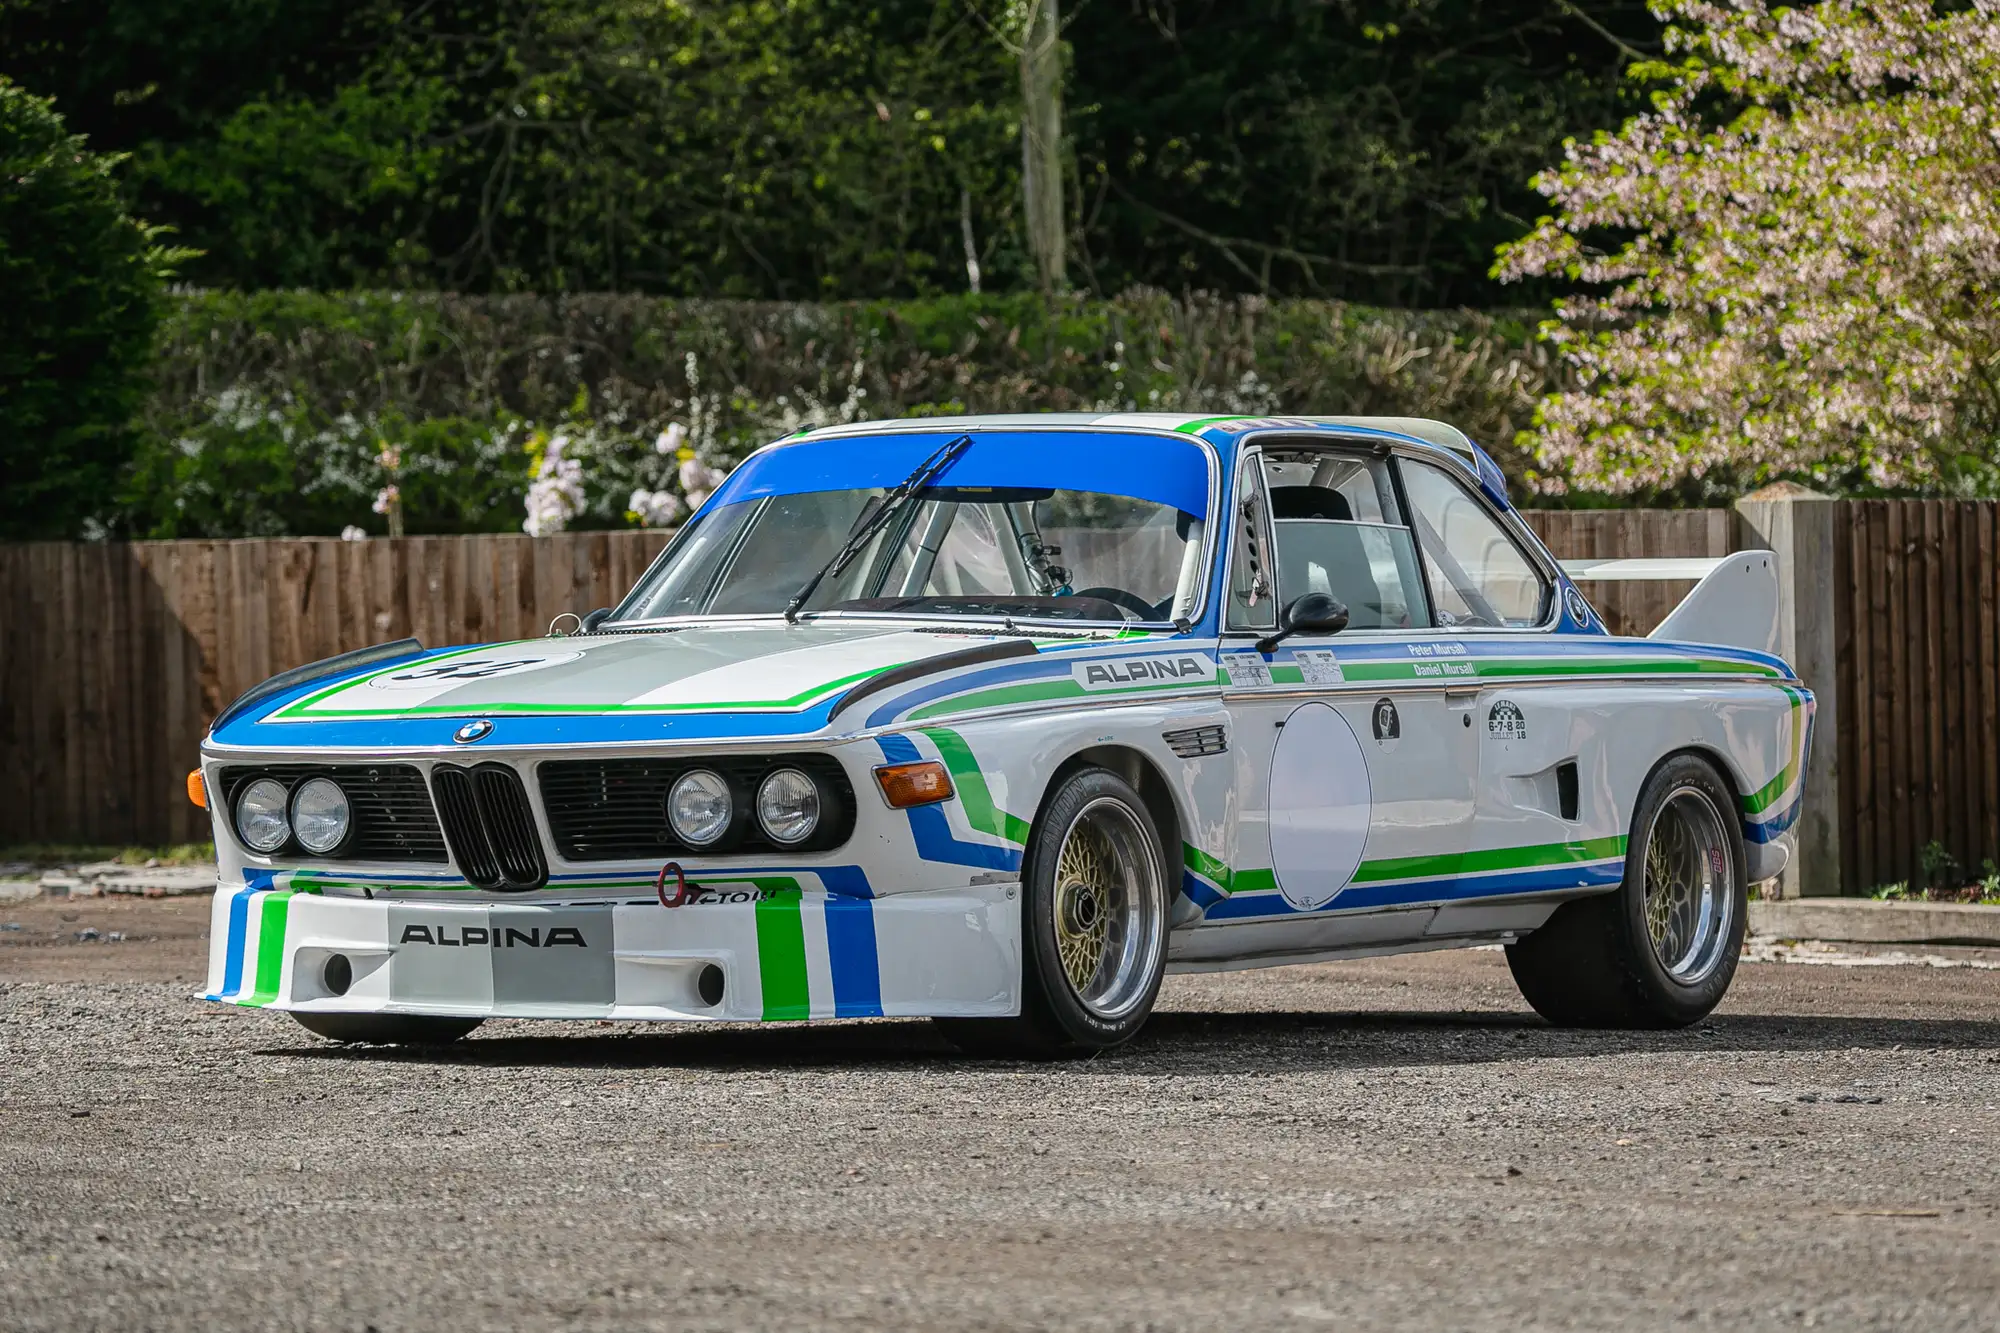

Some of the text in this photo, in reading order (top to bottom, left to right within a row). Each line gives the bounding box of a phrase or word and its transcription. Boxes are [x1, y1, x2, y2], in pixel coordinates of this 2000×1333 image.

[1407, 643, 1467, 656] Peter Mursall
[391, 659, 546, 680] 32
[1086, 658, 1205, 684] ALPINA
[1413, 661, 1475, 676] Daniel Mursall
[1489, 721, 1525, 731] 6-7-8 20
[1516, 731, 1526, 739] 18
[400, 924, 588, 948] ALPINA
